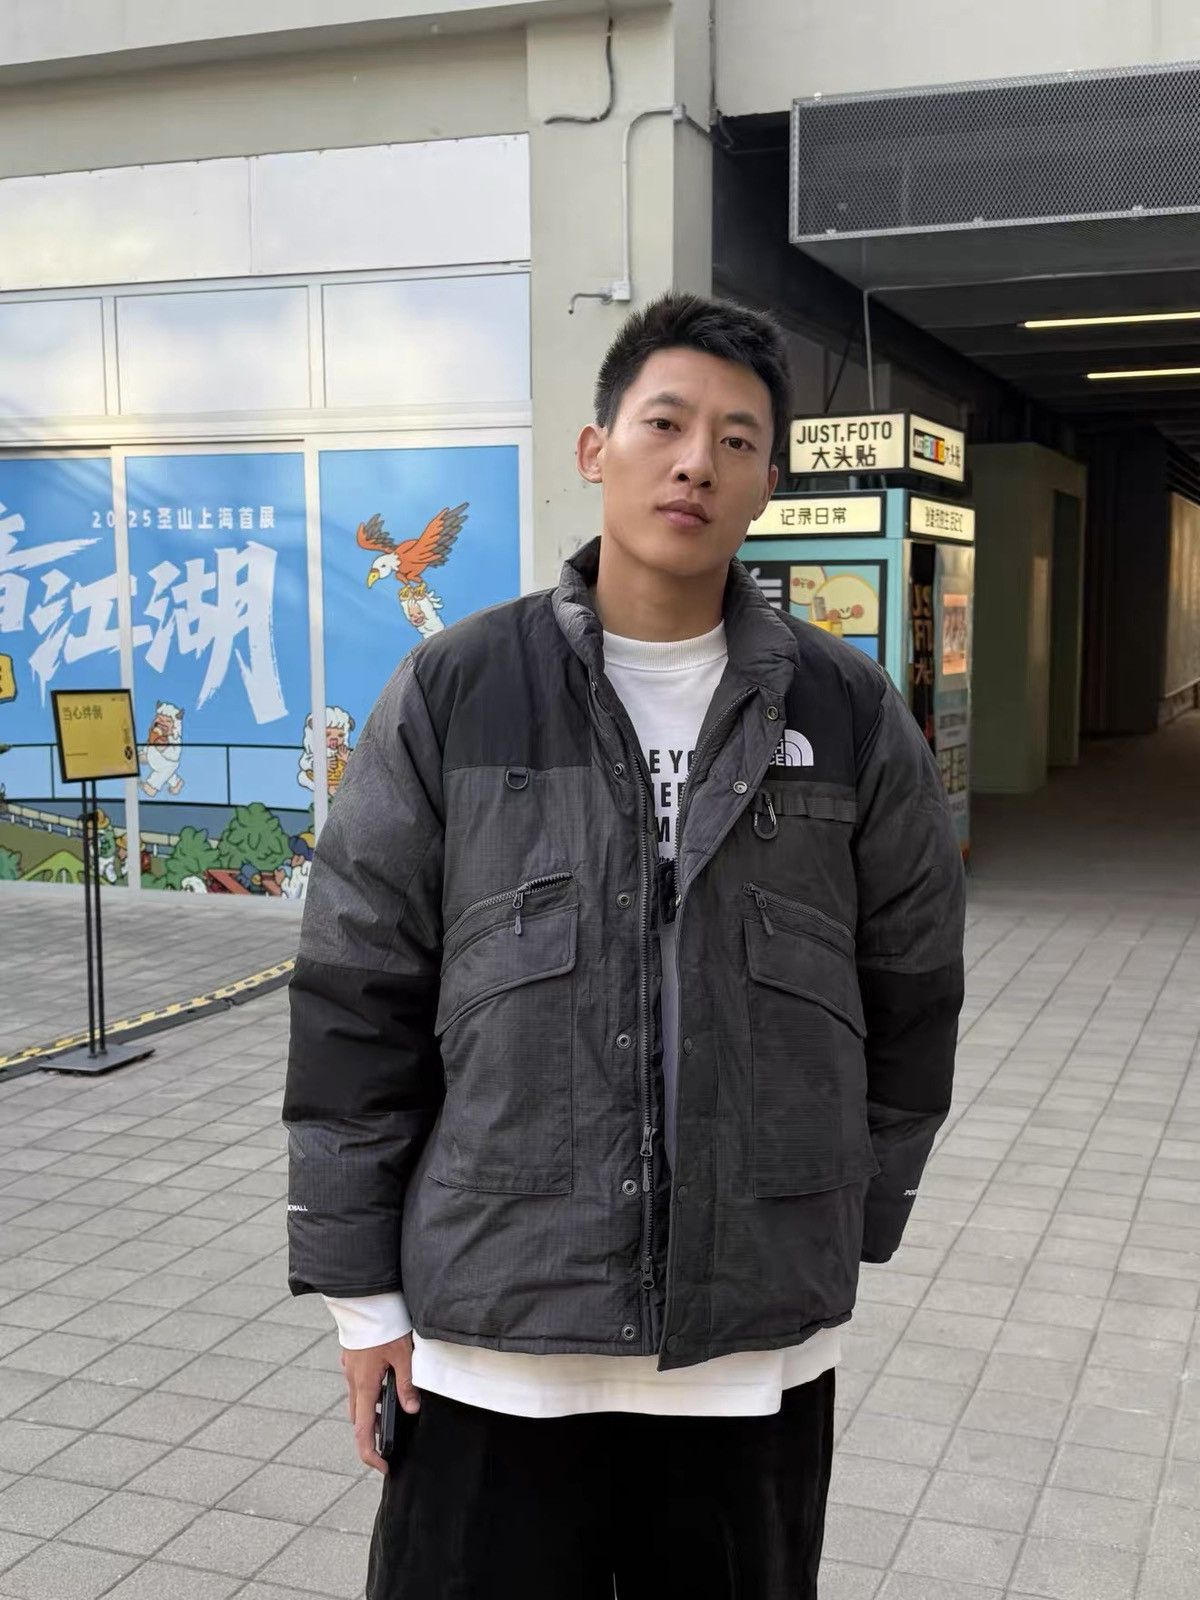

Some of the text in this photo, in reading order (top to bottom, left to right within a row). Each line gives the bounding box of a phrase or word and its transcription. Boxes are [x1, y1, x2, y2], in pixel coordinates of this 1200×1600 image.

[796, 421, 892, 444] JUST.FOTO
[811, 444, 876, 469] 大头贴
[780, 507, 847, 526] 记录日常
